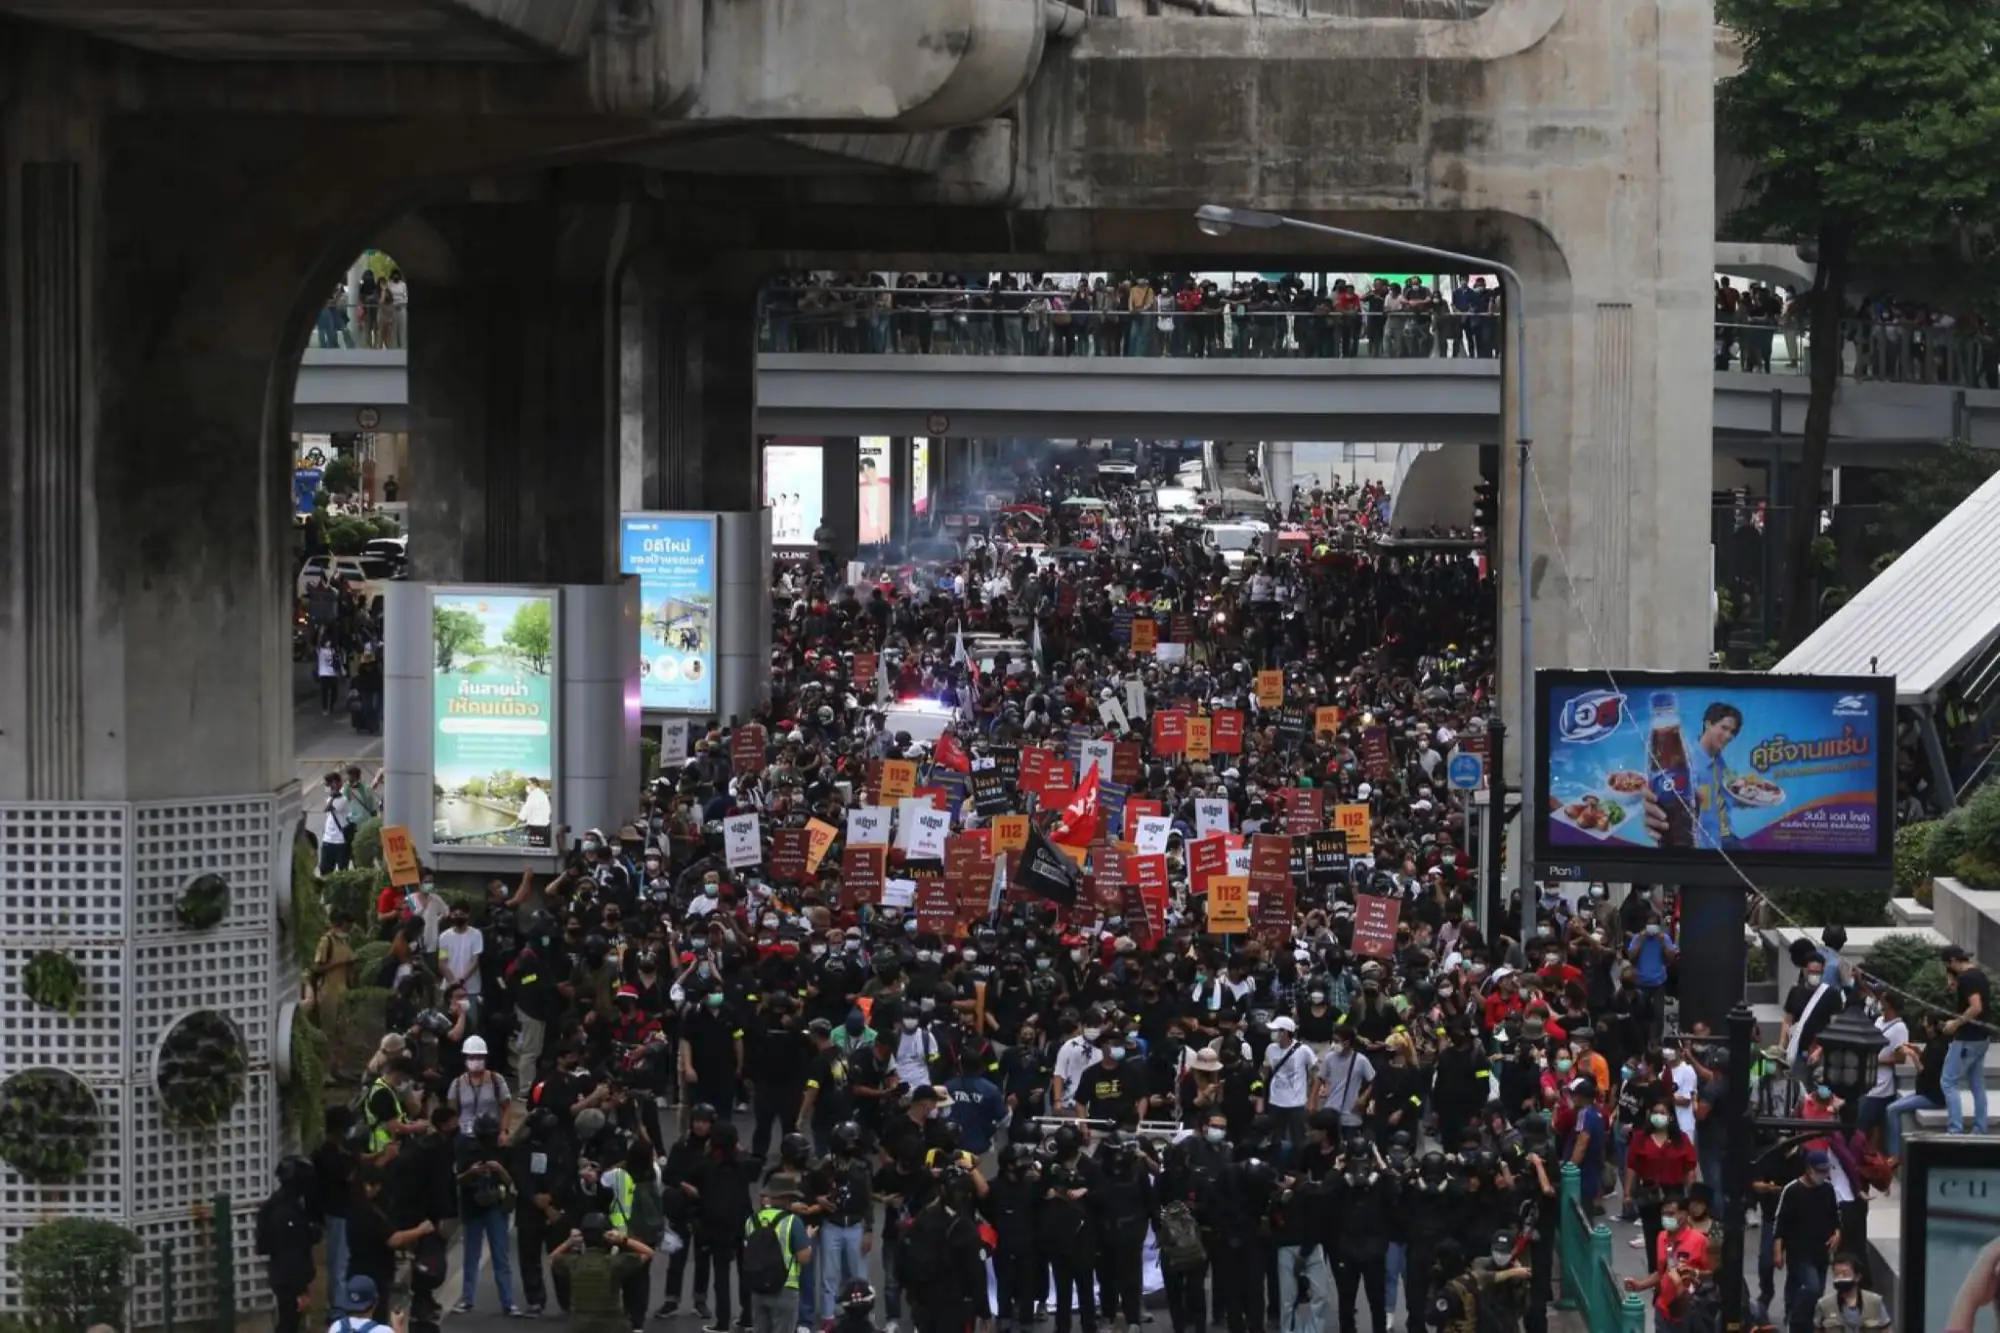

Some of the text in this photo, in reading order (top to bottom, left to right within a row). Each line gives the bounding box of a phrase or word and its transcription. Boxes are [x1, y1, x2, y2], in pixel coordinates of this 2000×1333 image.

[779, 551, 810, 560] CLINIC
[890, 768, 911, 782] 112
[1342, 813, 1364, 827] 112
[1000, 824, 1022, 838] 112
[388, 836, 407, 853] 112
[1549, 865, 1572, 876] Plan
[1217, 885, 1242, 901] 112
